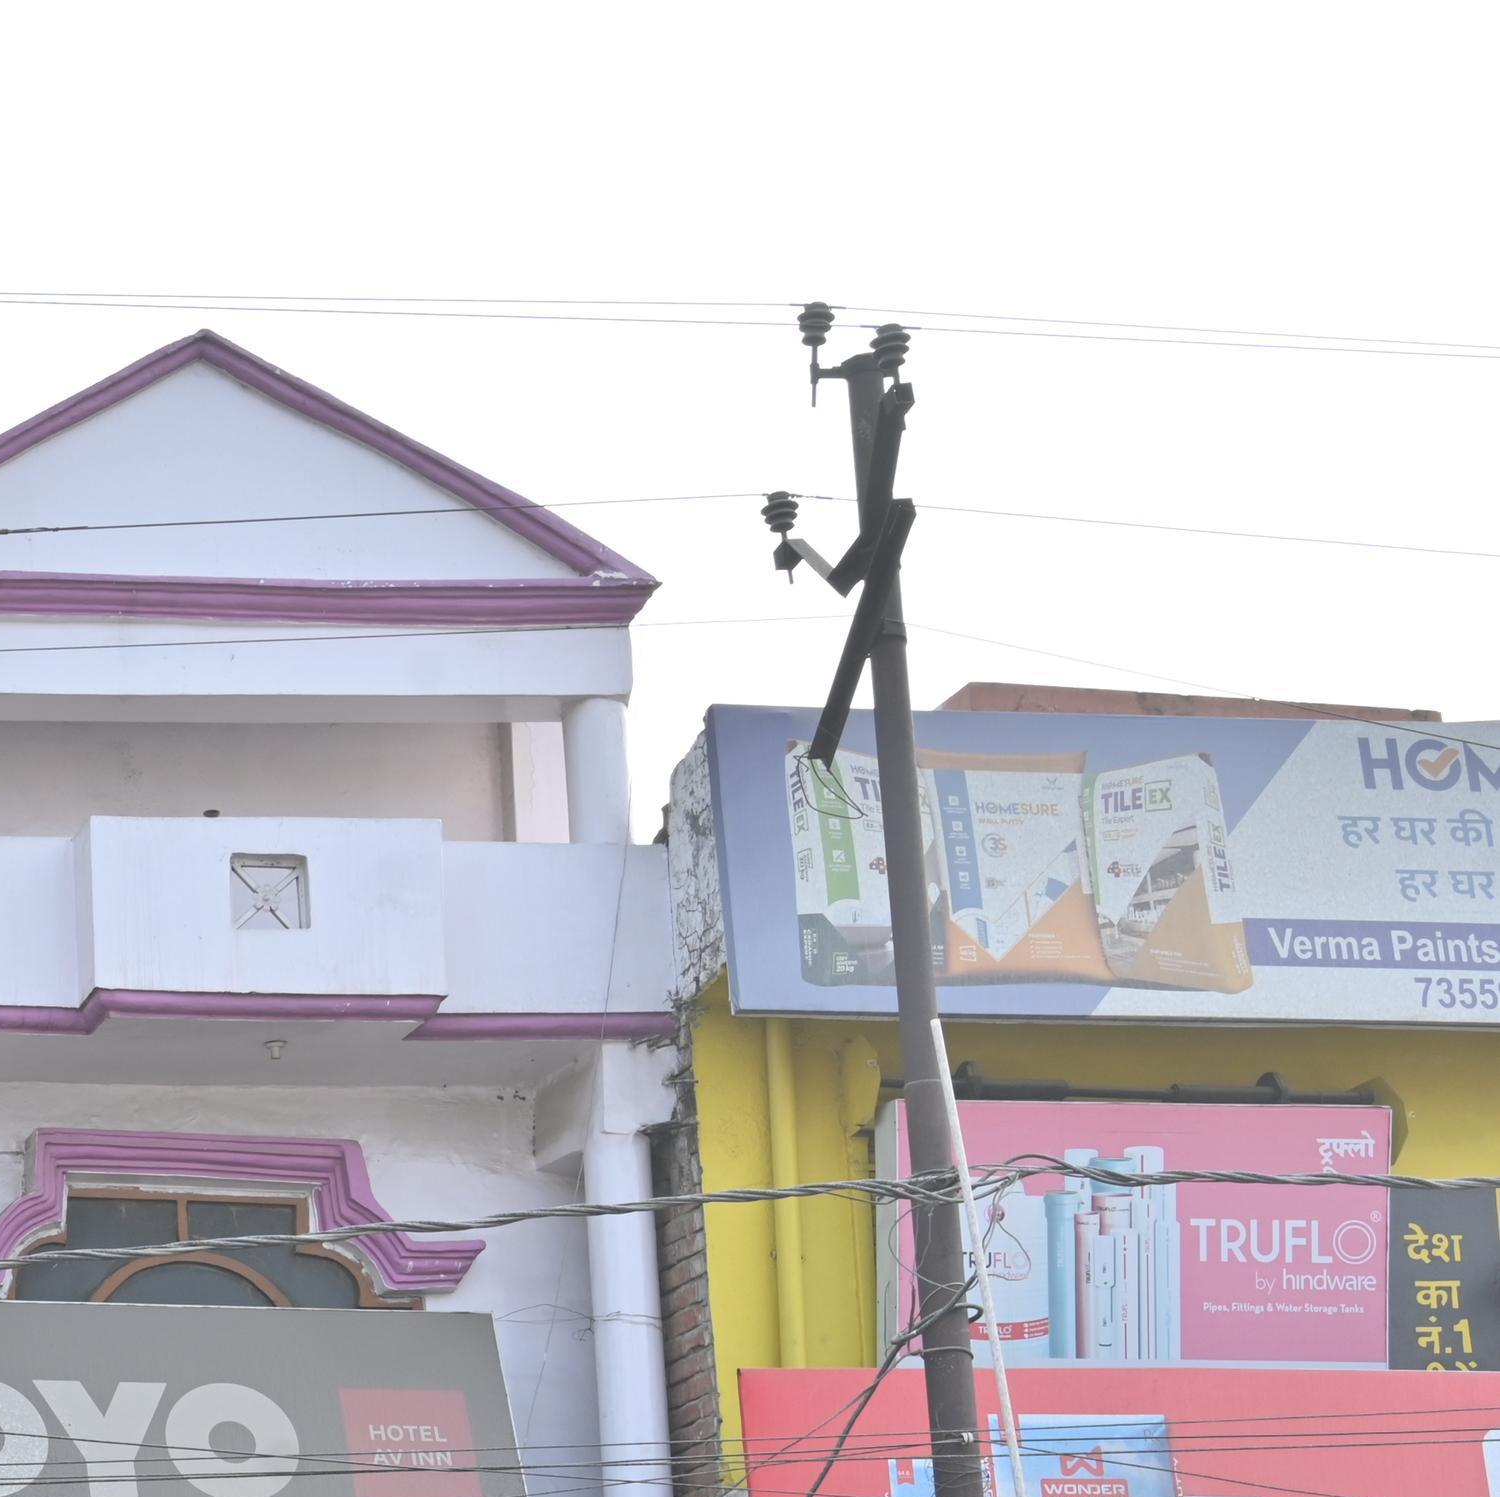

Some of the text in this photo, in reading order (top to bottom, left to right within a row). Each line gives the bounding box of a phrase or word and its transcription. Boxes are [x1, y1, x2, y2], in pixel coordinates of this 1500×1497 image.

[1268, 928, 1380, 960] Verma
[1190, 1219, 1376, 1264] TRUFLO
[1403, 1223, 1462, 1263] देश
[1256, 1269, 1376, 1294] by hindware
[1415, 1280, 1460, 1309] का
[1203, 1302, 1364, 1314] Pipes, Fittings & Water Storage Tanks
[369, 1424, 447, 1443] HOTEL
[372, 1448, 452, 1467] AV INN
[1045, 1483, 1125, 1495] WONDER
